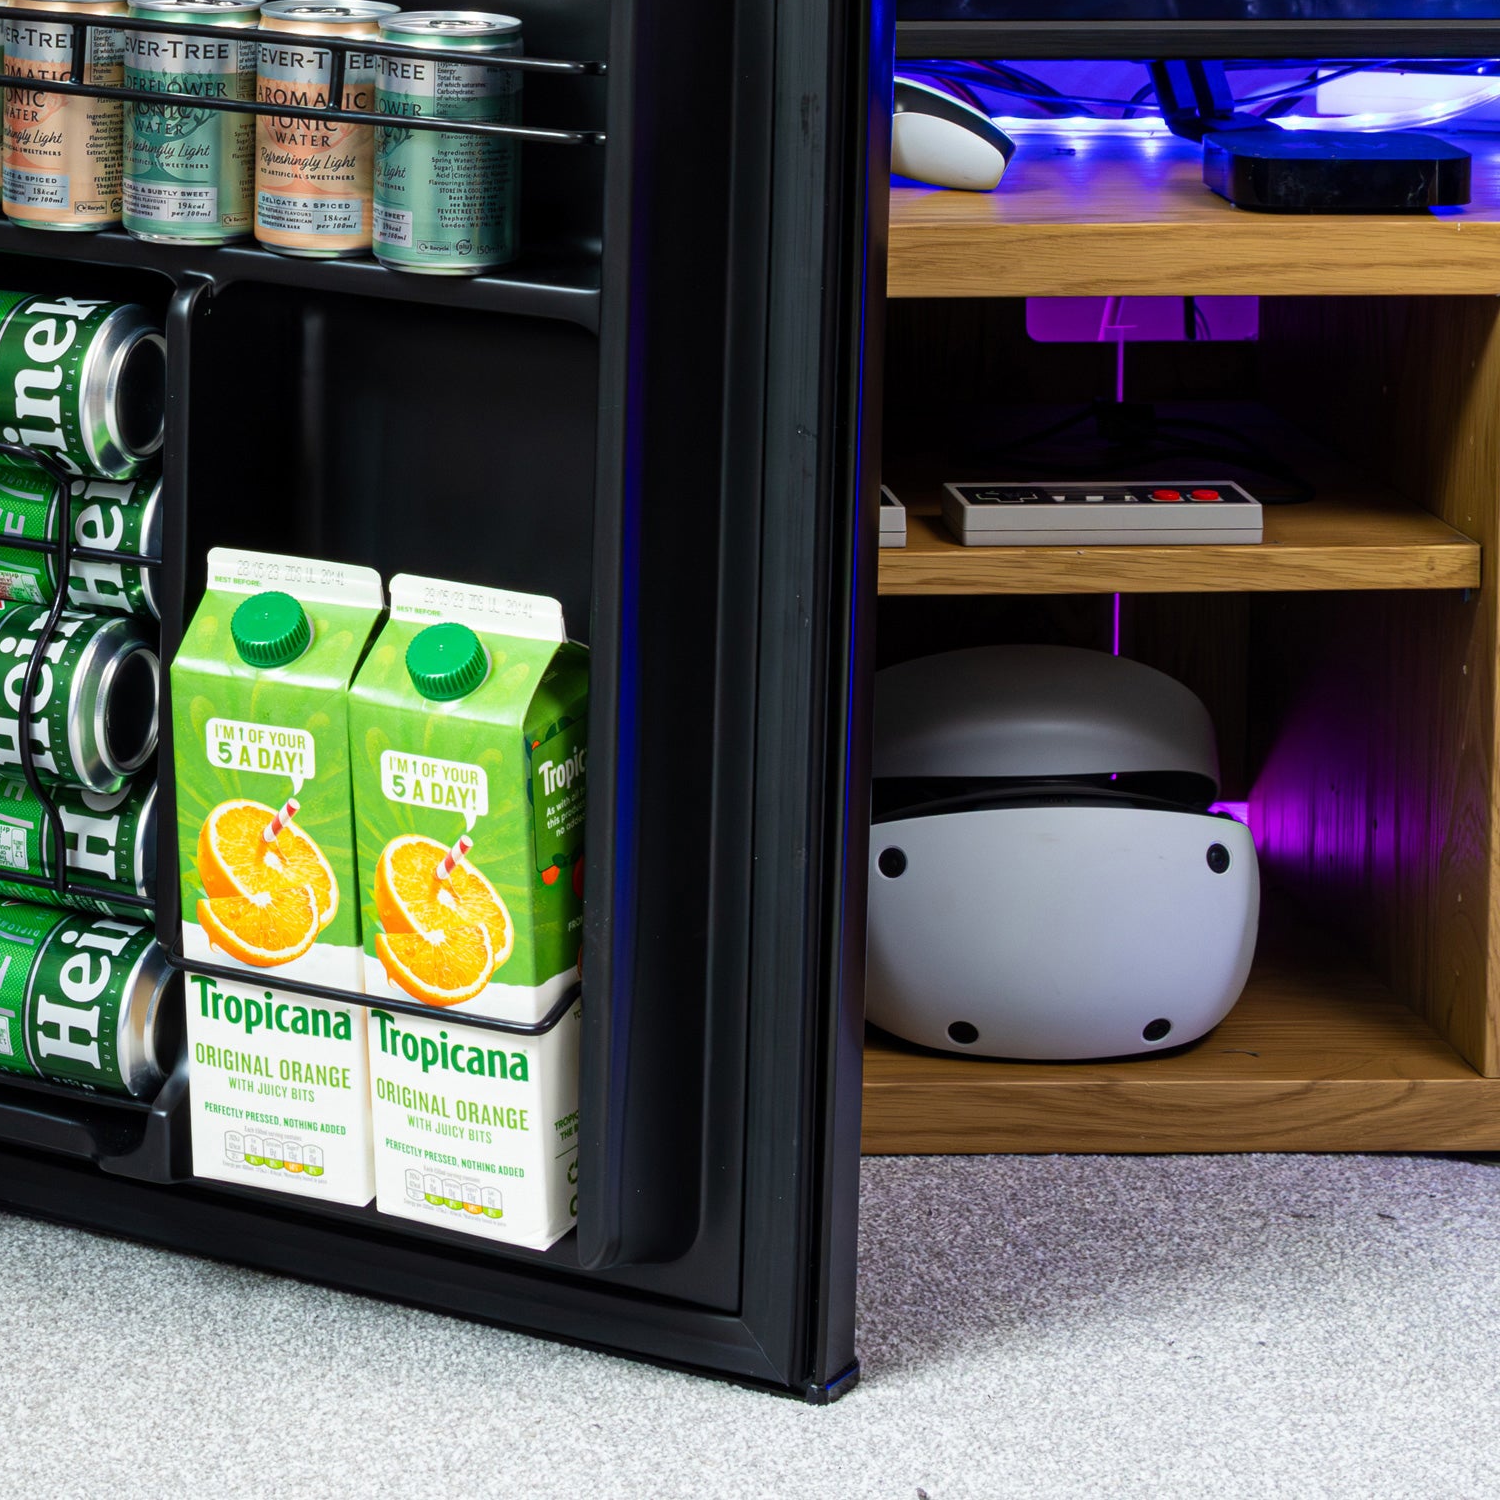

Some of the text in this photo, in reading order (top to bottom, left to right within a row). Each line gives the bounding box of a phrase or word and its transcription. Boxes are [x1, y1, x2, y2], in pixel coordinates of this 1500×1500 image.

[258, 85, 367, 109] AROMAIC
[134, 120, 185, 136] WATER
[32, 130, 63, 147] Light
[275, 129, 331, 147] WATER
[19, 147, 62, 157] SWEETENERS
[178, 142, 211, 160] Light
[260, 146, 357, 173] Refreshingly Light
[161, 162, 210, 170] SWEETENERS
[268, 169, 355, 181] ARTIFICIAL SWEETENERS
[383, 162, 407, 181] Light
[25, 175, 57, 184] SPICED
[27, 195, 64, 204] per 100ml
[33, 187, 58, 196] 18kcal
[148, 187, 178, 196] SUBTLY
[261, 196, 298, 208] DELICATE
[323, 214, 352, 222] 18kcal
[384, 211, 406, 220] SWEET
[332, 222, 357, 230] 100ml
[65, 344, 82, 391] MALT
[214, 575, 262, 587] BEST BEFORE:
[396, 605, 441, 617] BEST BEFORE:
[53, 700, 72, 777] QUALITY
[214, 723, 305, 750] I'M 1 OF YOUR
[218, 741, 304, 775] 5 A DAY!
[389, 755, 479, 786] I'M 1 OF YOUR
[391, 774, 477, 811] 5 A DAY!
[546, 797, 570, 818] As with
[547, 817, 560, 830] this
[555, 825, 565, 838] no
[190, 974, 352, 1042] Tropicana
[102, 988, 117, 1073] QUALITY
[370, 1008, 530, 1082] Tropicana
[195, 1042, 351, 1090] ORIGINAL ORANGE
[228, 1076, 315, 1103] WITH JUICY BITS
[376, 1077, 530, 1132] ORIGINAL ORANGE
[204, 1101, 244, 1120] PERFECTLY
[245, 1110, 282, 1127] PRESSED,
[283, 1117, 318, 1132] NOTHING
[320, 1123, 347, 1136] ADDED
[407, 1114, 492, 1145] WITH JUICY BITS
[560, 1127, 574, 1142] THE
[385, 1137, 423, 1159] PERFECTLY
[424, 1150, 460, 1168] PRESSED,
[461, 1158, 496, 1174] NOTHING
[498, 1165, 525, 1178] ADDED
